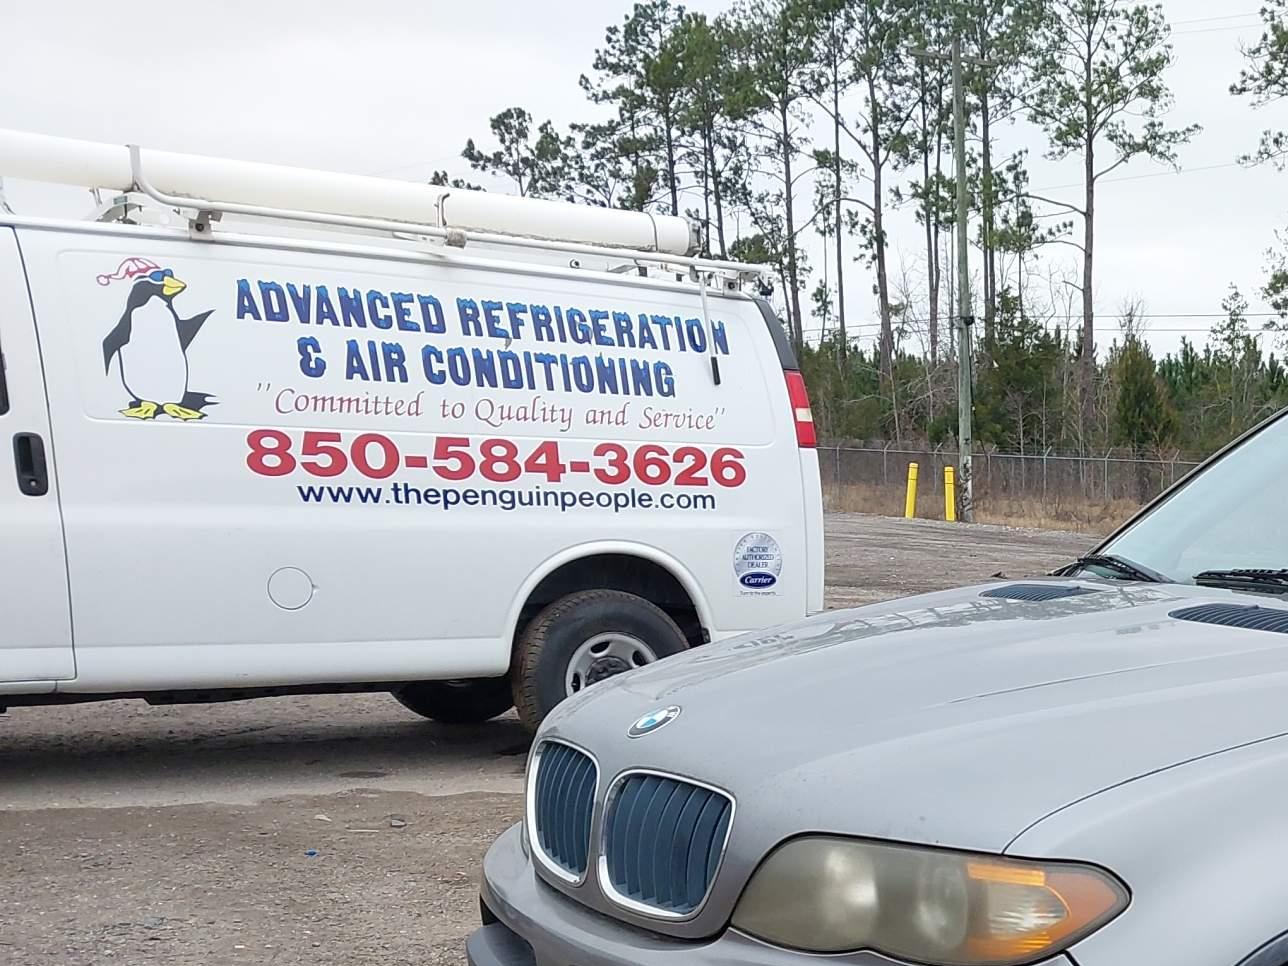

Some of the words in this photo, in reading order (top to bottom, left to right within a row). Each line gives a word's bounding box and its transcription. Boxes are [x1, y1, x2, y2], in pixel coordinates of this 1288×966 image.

[237, 278, 447, 334] ADVANCED
[456, 297, 730, 355] REFRIGERATION
[297, 336, 327, 378] &
[345, 339, 409, 383] AIR
[421, 344, 676, 398] CONDITIONING
[257, 382, 425, 417] "Committed
[440, 399, 465, 419] to
[475, 395, 573, 432] Quality
[585, 401, 630, 426] and
[638, 406, 726, 431] Service"
[246, 428, 747, 487] 850-584-3626
[297, 482, 716, 512] www.thepenguinpeople.com
[744, 575, 773, 584] Carrier
